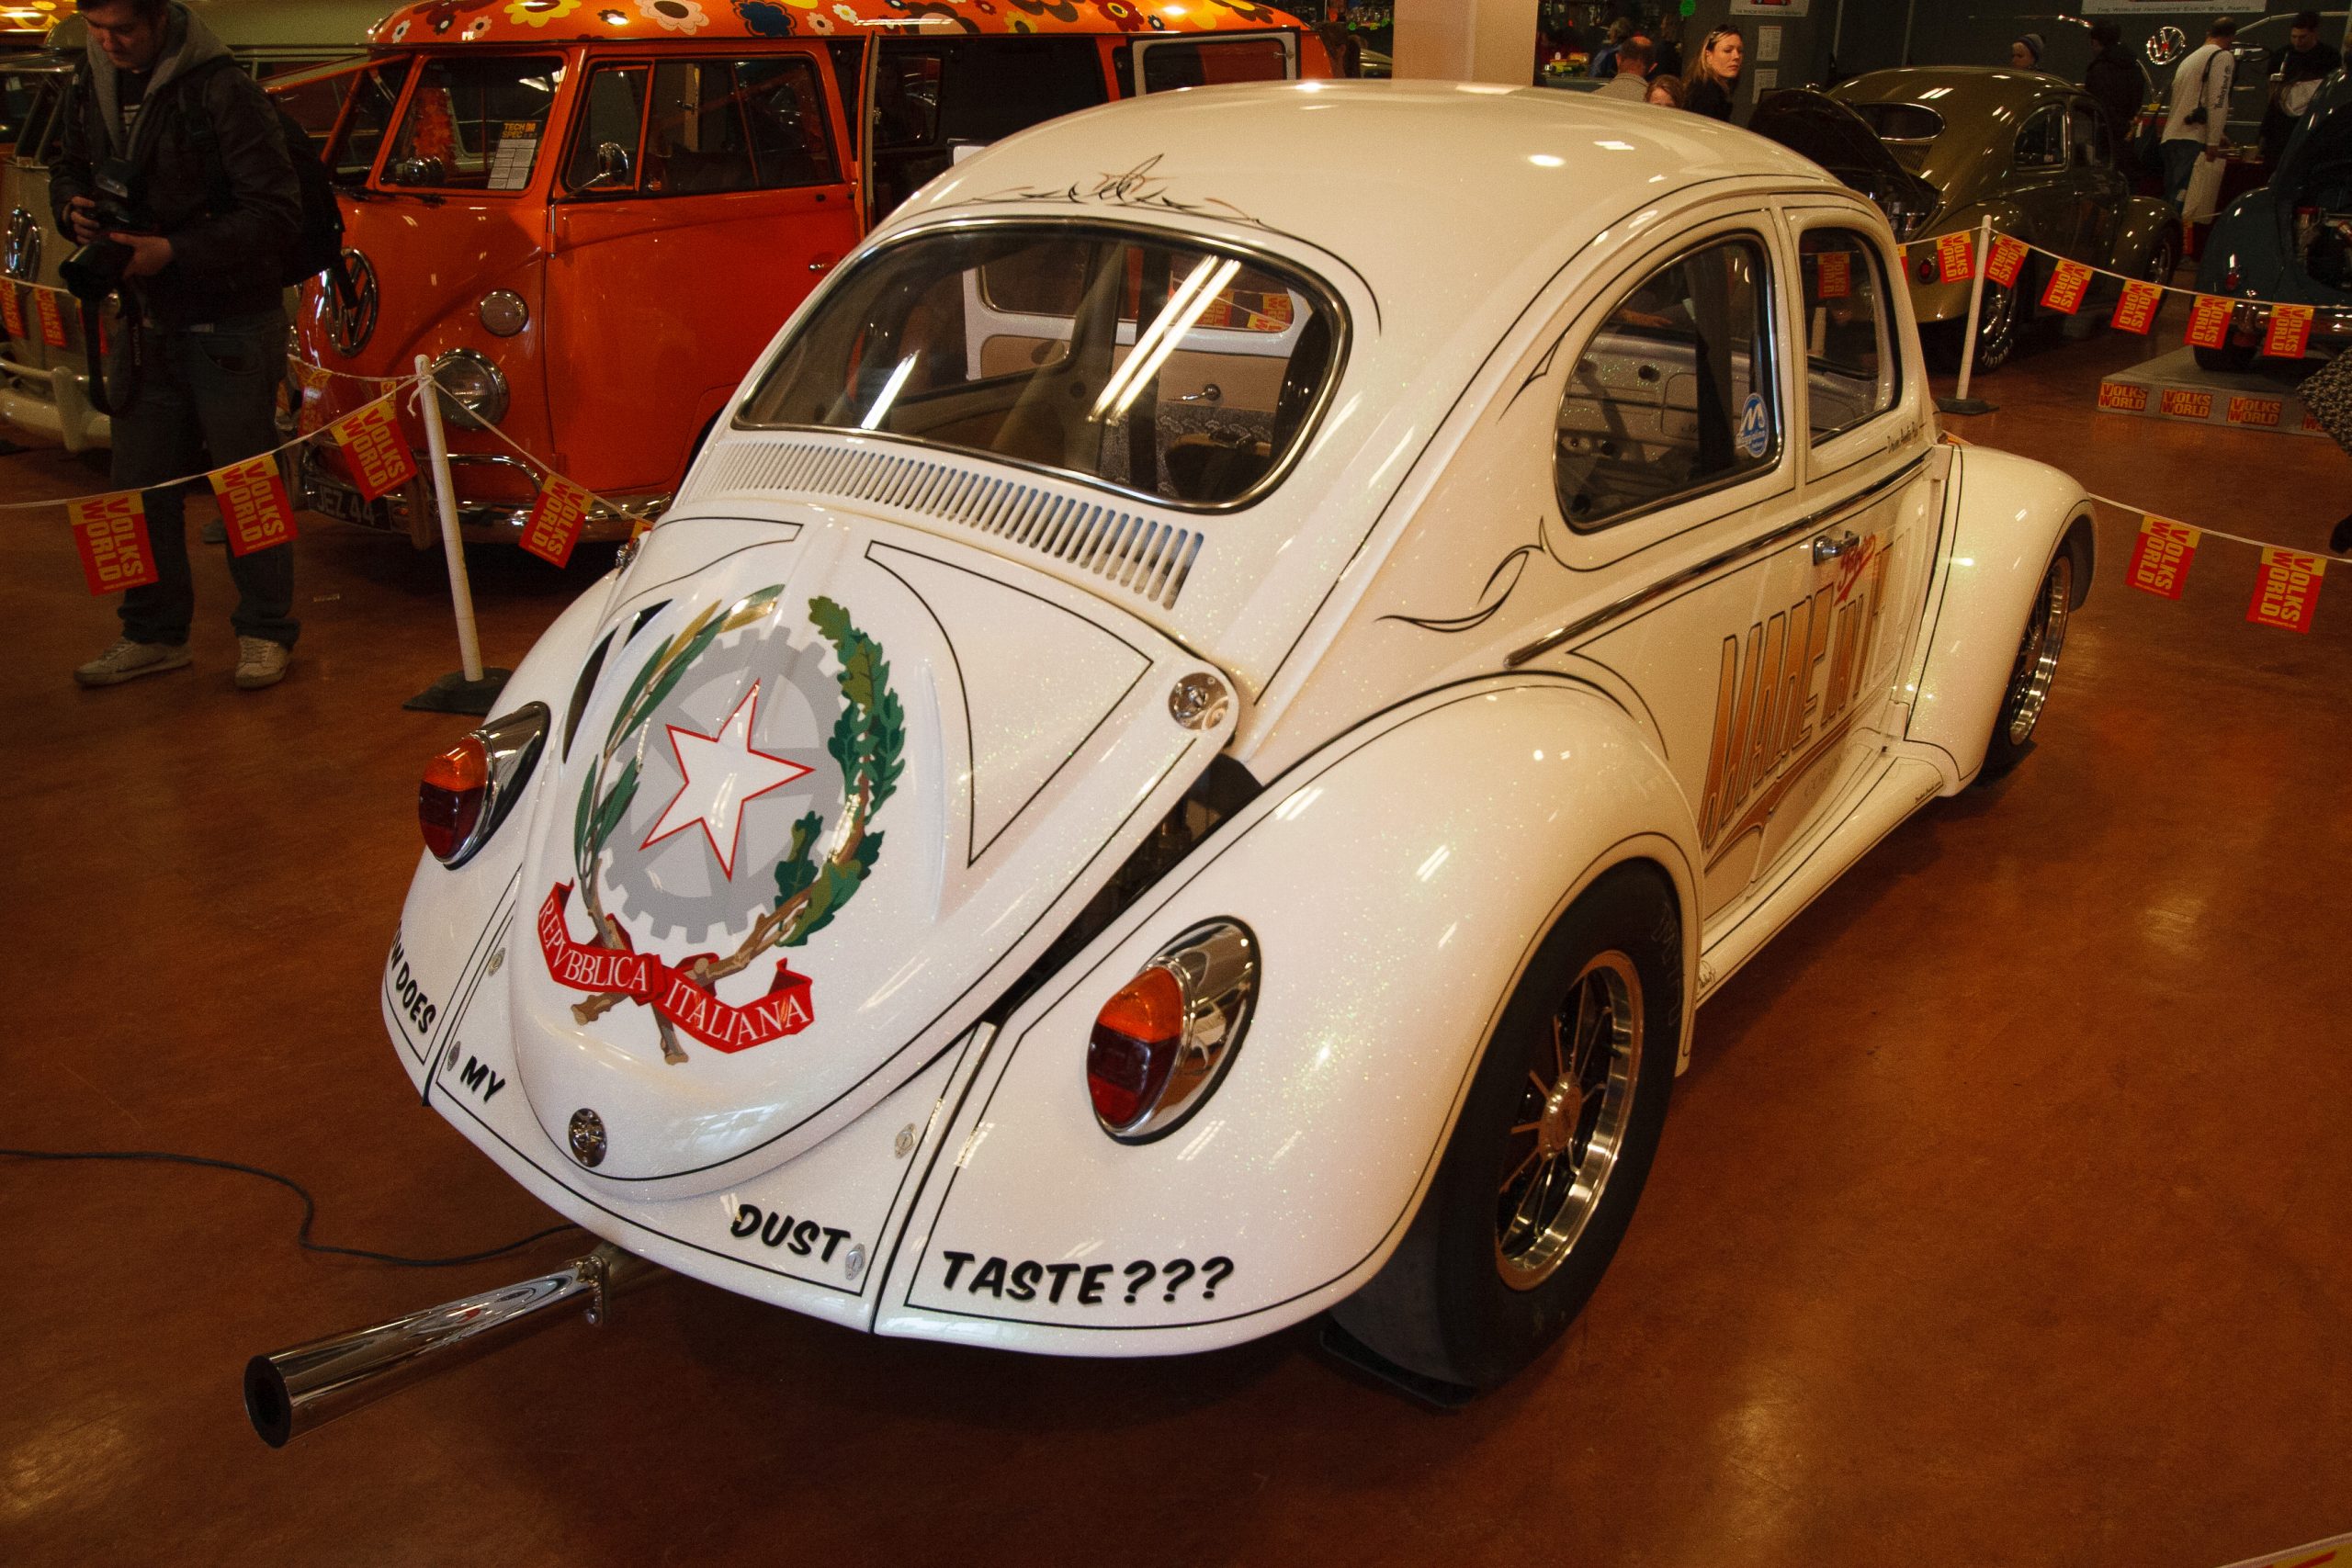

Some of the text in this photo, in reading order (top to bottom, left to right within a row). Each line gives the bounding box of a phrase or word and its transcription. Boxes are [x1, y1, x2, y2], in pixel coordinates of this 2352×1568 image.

[1941, 236, 1957, 278] WORLD
[1952, 234, 1969, 276] VOLKS
[1988, 238, 2013, 276] WORLD
[1998, 243, 2022, 282] VOLKS
[2048, 263, 2075, 304] WORLD
[2060, 267, 2085, 309] VOLKS
[2119, 283, 2143, 325] WORLD
[2131, 287, 2155, 328] VOLKS
[2191, 297, 2215, 341] WORLD
[2204, 299, 2228, 344] VOLKS
[2271, 306, 2293, 351] WORLD
[2284, 308, 2306, 353] VOLKS
[2098, 395, 2145, 410] WORLD
[2101, 382, 2147, 400] VOLKS
[2161, 401, 2210, 418] WORLD
[2164, 389, 2212, 406] VOLKS
[2231, 397, 2281, 413] VOLKS
[2228, 410, 2279, 423] WORLD
[341, 416, 388, 487] WORLD
[363, 407, 406, 479] VOLKS
[221, 466, 265, 544] WORLD
[244, 460, 285, 538] VOLKS
[532, 480, 571, 548] WORLD
[81, 499, 122, 581] WORLD
[107, 497, 144, 578] VOLKS
[547, 491, 585, 556] VOLKS
[2137, 521, 2172, 584] WORLD
[2154, 529, 2191, 590] VOLKS
[2260, 551, 2294, 617] WORLD
[2280, 558, 2315, 622] VOLKS
[1700, 582, 1834, 852] MADE
[539, 900, 810, 1045] REPVBBLICA ITALIANA
[395, 961, 437, 1034] DOES
[460, 1055, 506, 1103] MY
[730, 1203, 852, 1263] DUST
[943, 1250, 1235, 1305] TASTE???
